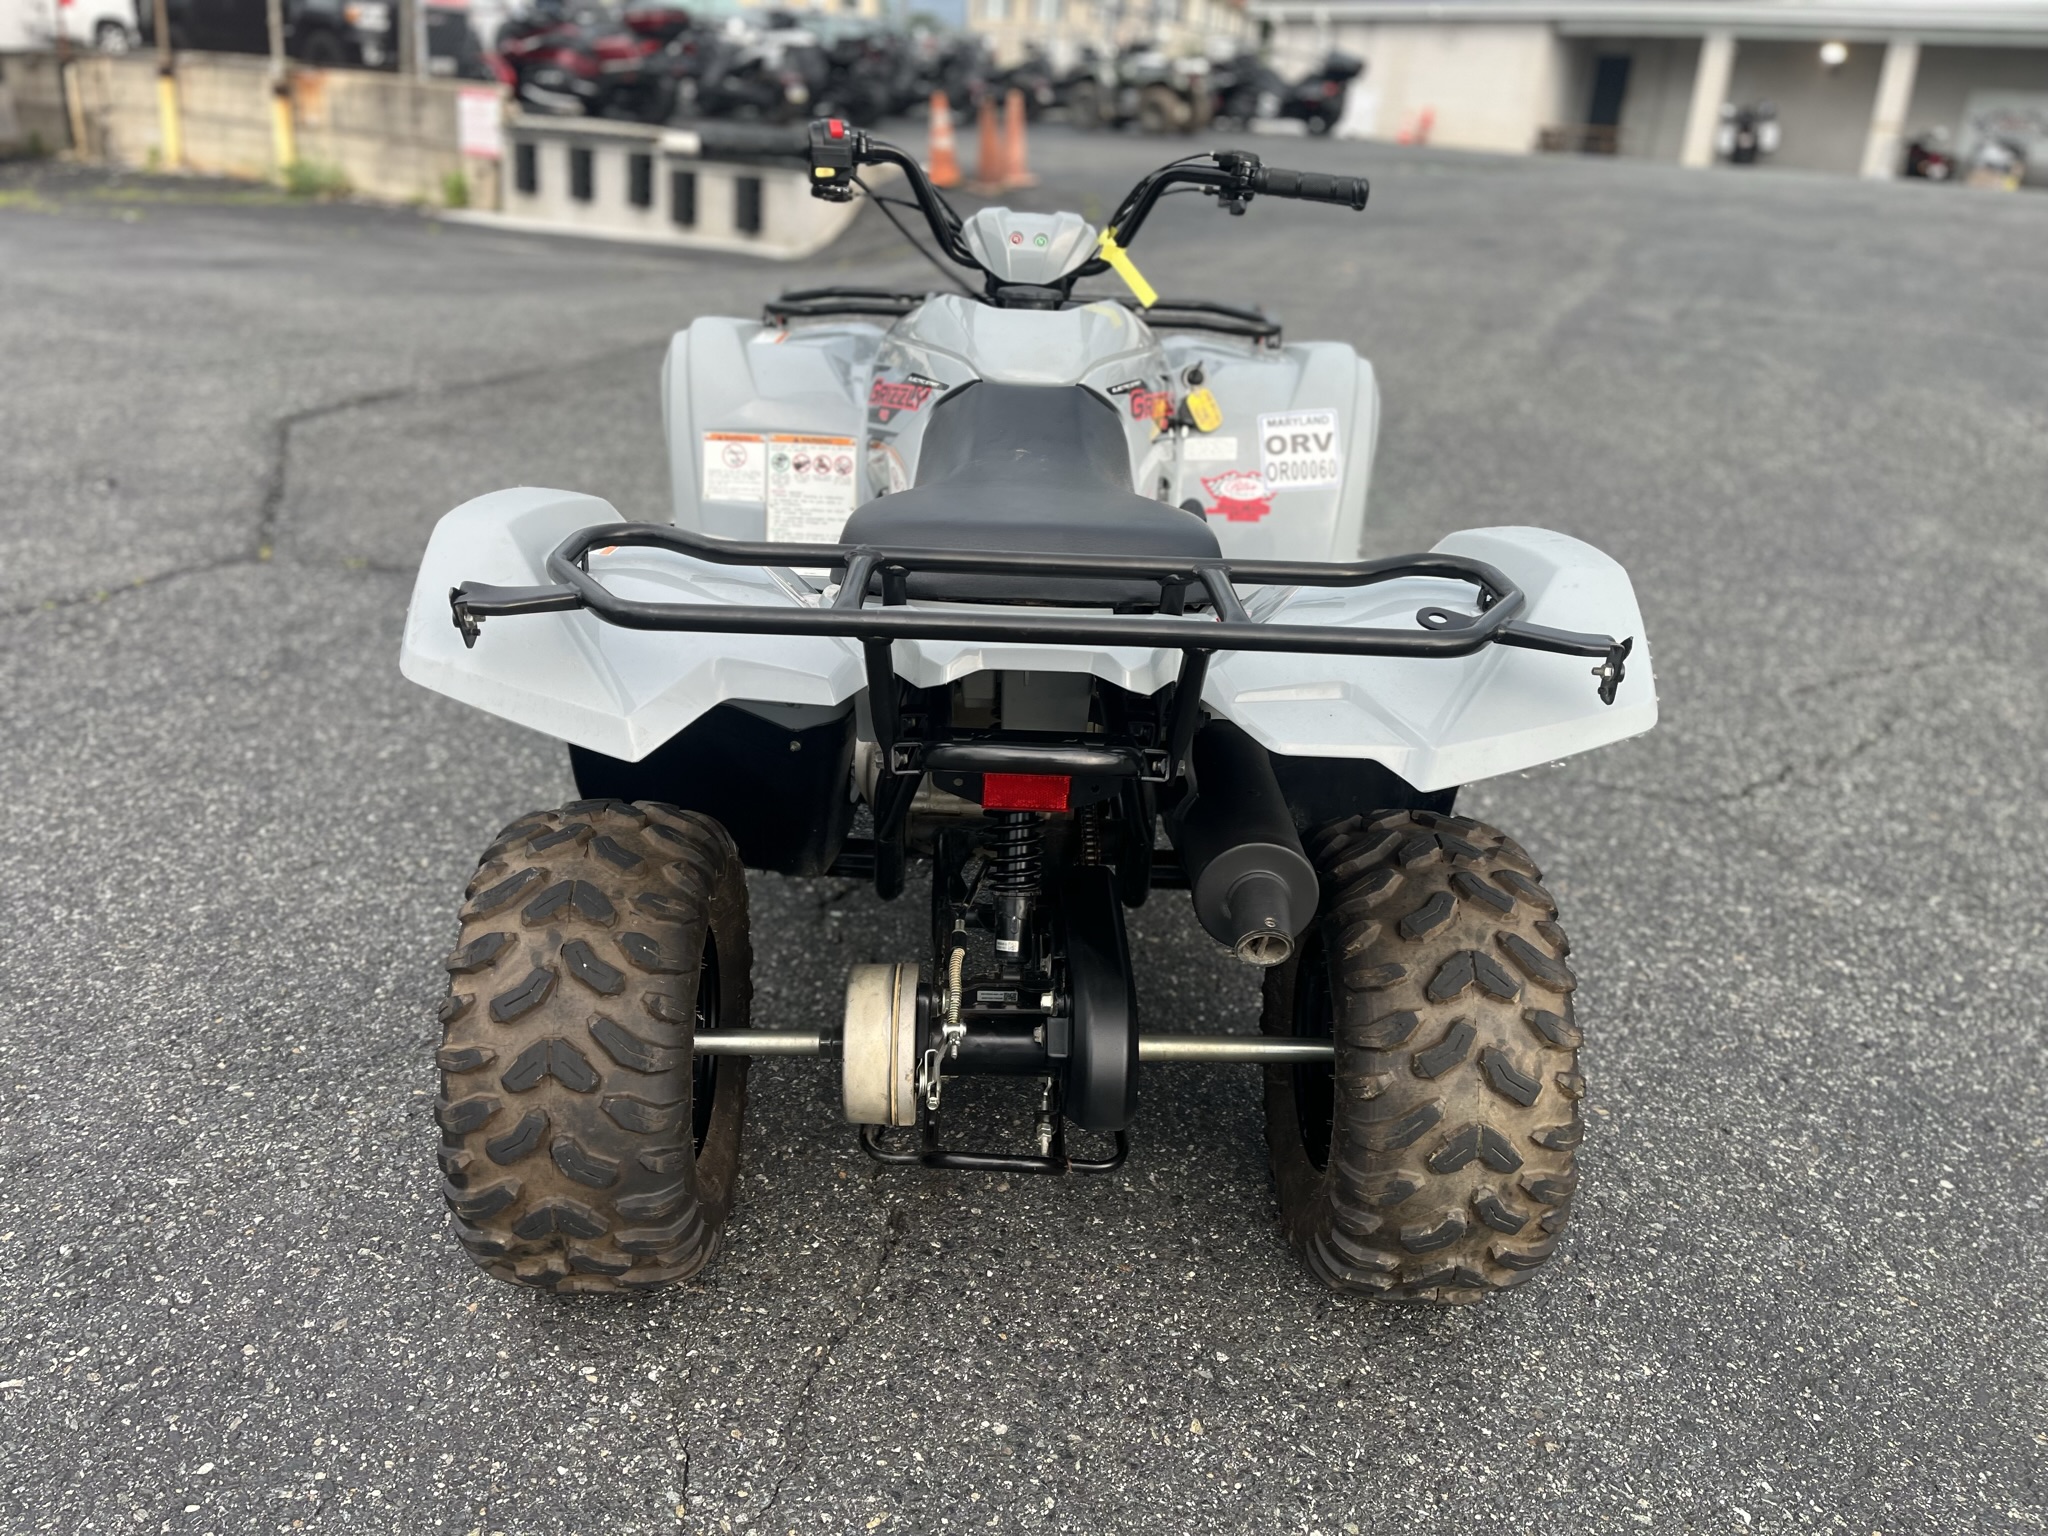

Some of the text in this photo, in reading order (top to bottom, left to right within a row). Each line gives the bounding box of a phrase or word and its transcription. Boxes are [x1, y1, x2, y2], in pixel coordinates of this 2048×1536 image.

[1267, 415, 1330, 428] MARYLAND
[1265, 431, 1333, 456] ORV
[1265, 459, 1337, 482] OR00060
